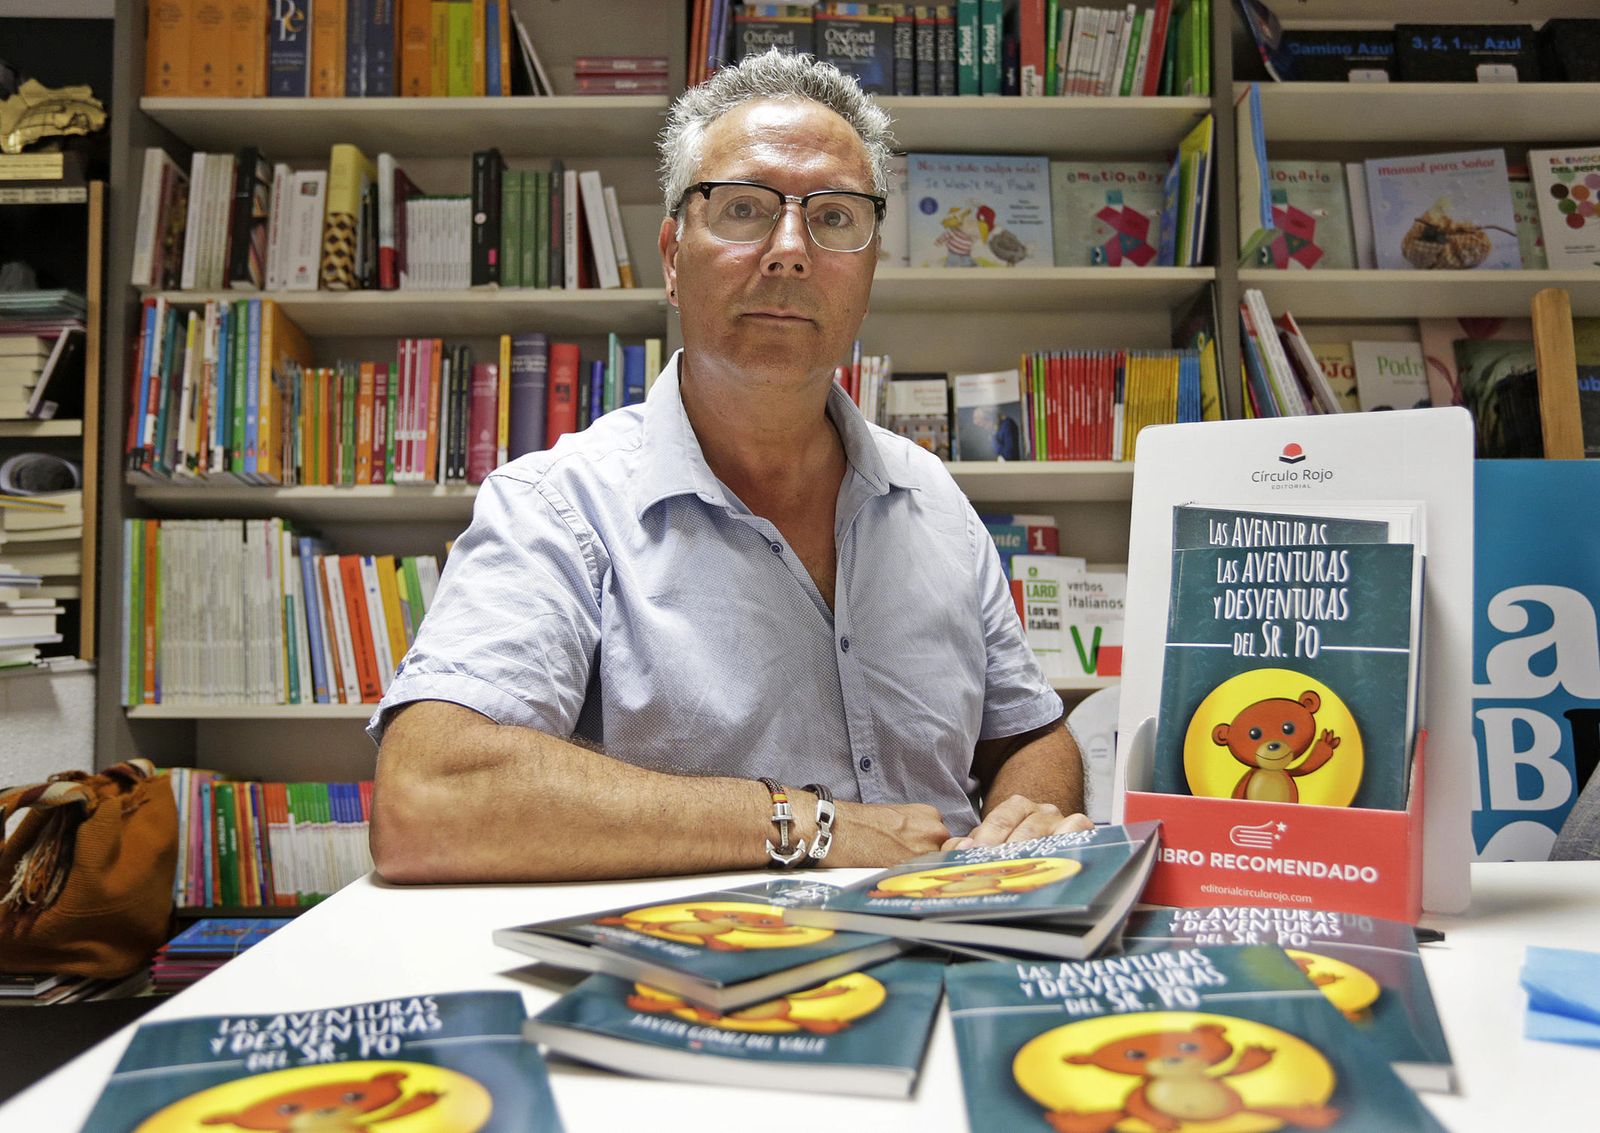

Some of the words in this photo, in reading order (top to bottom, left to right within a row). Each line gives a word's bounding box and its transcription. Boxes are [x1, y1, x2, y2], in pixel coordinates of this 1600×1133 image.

[743, 30, 796, 44] Oxford
[824, 28, 876, 43] Oxford
[959, 25, 972, 66] School
[982, 23, 995, 64] School
[1484, 38, 1521, 49] Azul
[1252, 469, 1298, 483] Círculo
[1302, 468, 1334, 483] Rojo
[1033, 529, 1046, 551] 1
[1231, 517, 1328, 547] AVENTURAS
[1241, 550, 1350, 583] AVENTURAS
[1067, 581, 1103, 592] verbos
[1068, 596, 1124, 609] italianos
[1224, 587, 1350, 621] DESVENTURAS
[1294, 621, 1321, 659] PO
[1210, 851, 1379, 883] RECOMENDADO
[1183, 918, 1344, 937] DESVENTURAS
[1205, 907, 1339, 924] AVENTURAS
[1276, 930, 1309, 947] PO
[1059, 948, 1213, 980] AVENTURAS
[1038, 965, 1229, 999] DESVENTURAS
[1156, 985, 1201, 1010] PO
[266, 996, 440, 1032] AVENTURAS
[230, 1012, 444, 1054] DESVENTURAS
[778, 1034, 828, 1053] VALLE
